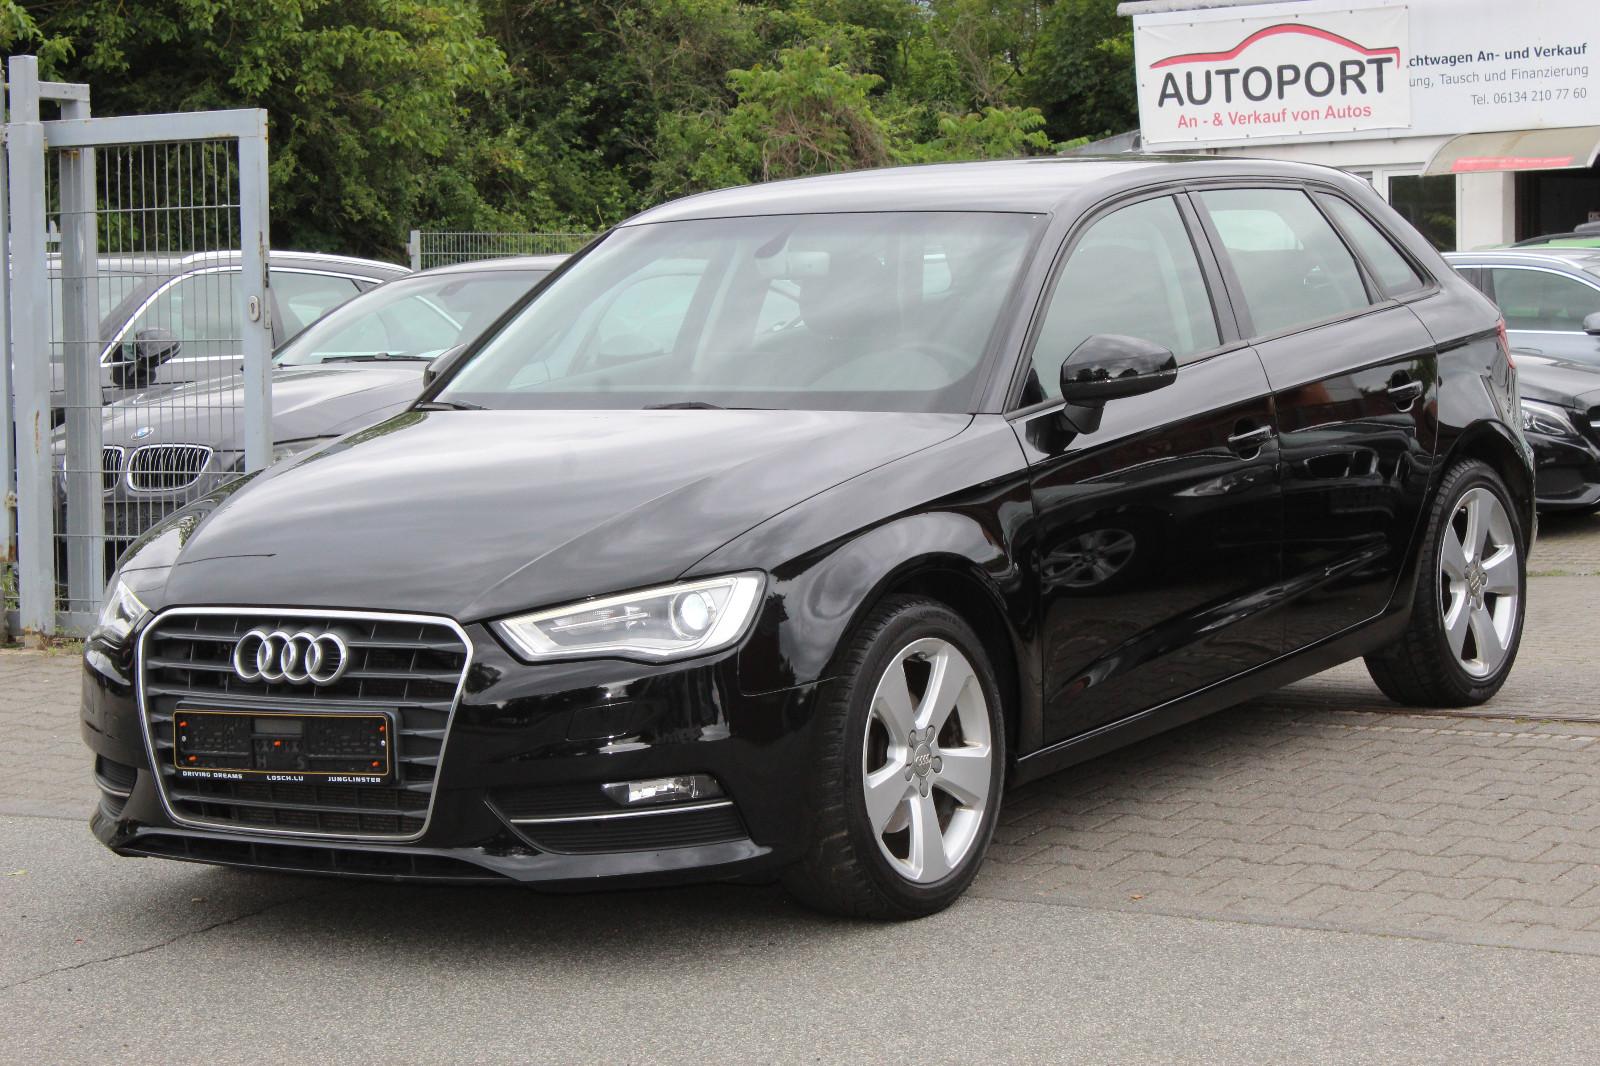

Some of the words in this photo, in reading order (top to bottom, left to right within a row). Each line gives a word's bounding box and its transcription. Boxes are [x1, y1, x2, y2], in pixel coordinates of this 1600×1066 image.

[1477, 50, 1500, 63] An-
[1504, 47, 1529, 60] und
[1534, 43, 1588, 58] Verkauf
[1157, 56, 1394, 108] AUTOPORT
[1440, 71, 1480, 85] Tausch
[1484, 69, 1506, 82] und
[1511, 65, 1589, 81] Finanzierung
[1471, 93, 1490, 105] Tel.
[1493, 91, 1527, 104] 06134
[1531, 89, 1552, 102] 210
[1556, 88, 1570, 100] 77
[1573, 87, 1587, 99] 60
[1212, 112, 1224, 127] &
[1228, 106, 1287, 126] Verkauf
[1292, 108, 1321, 121] von
[1324, 104, 1373, 119] Autos
[182, 770, 211, 778] DRIVING
